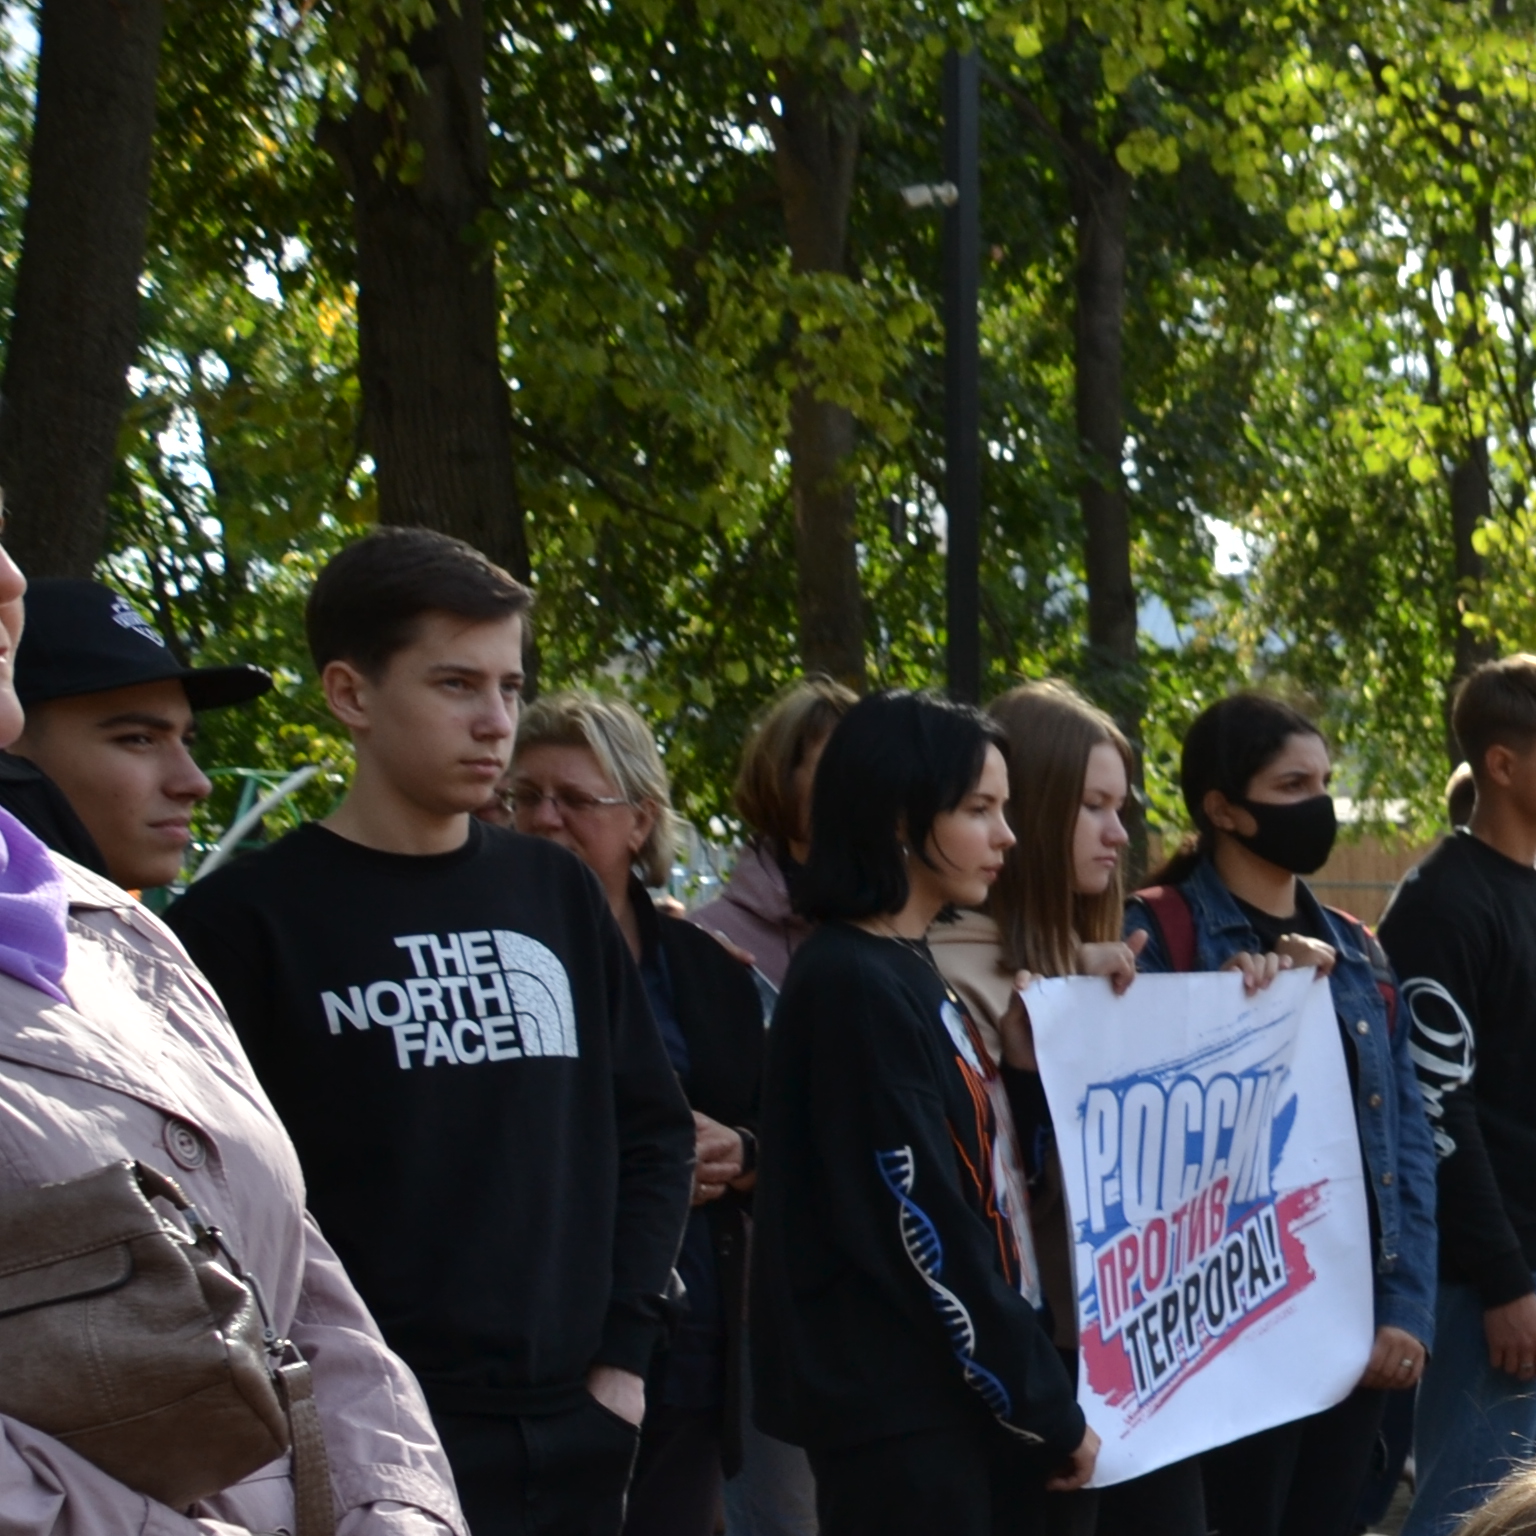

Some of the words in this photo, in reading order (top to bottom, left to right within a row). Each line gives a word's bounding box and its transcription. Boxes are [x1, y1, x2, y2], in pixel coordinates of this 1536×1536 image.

[394, 930, 500, 977] THE
[320, 973, 513, 1035] NORTH
[392, 1014, 523, 1070] FACE
[1097, 1174, 1230, 1331] ПРОТИВ
[1125, 1209, 1284, 1395] ТЕРРОРА!
